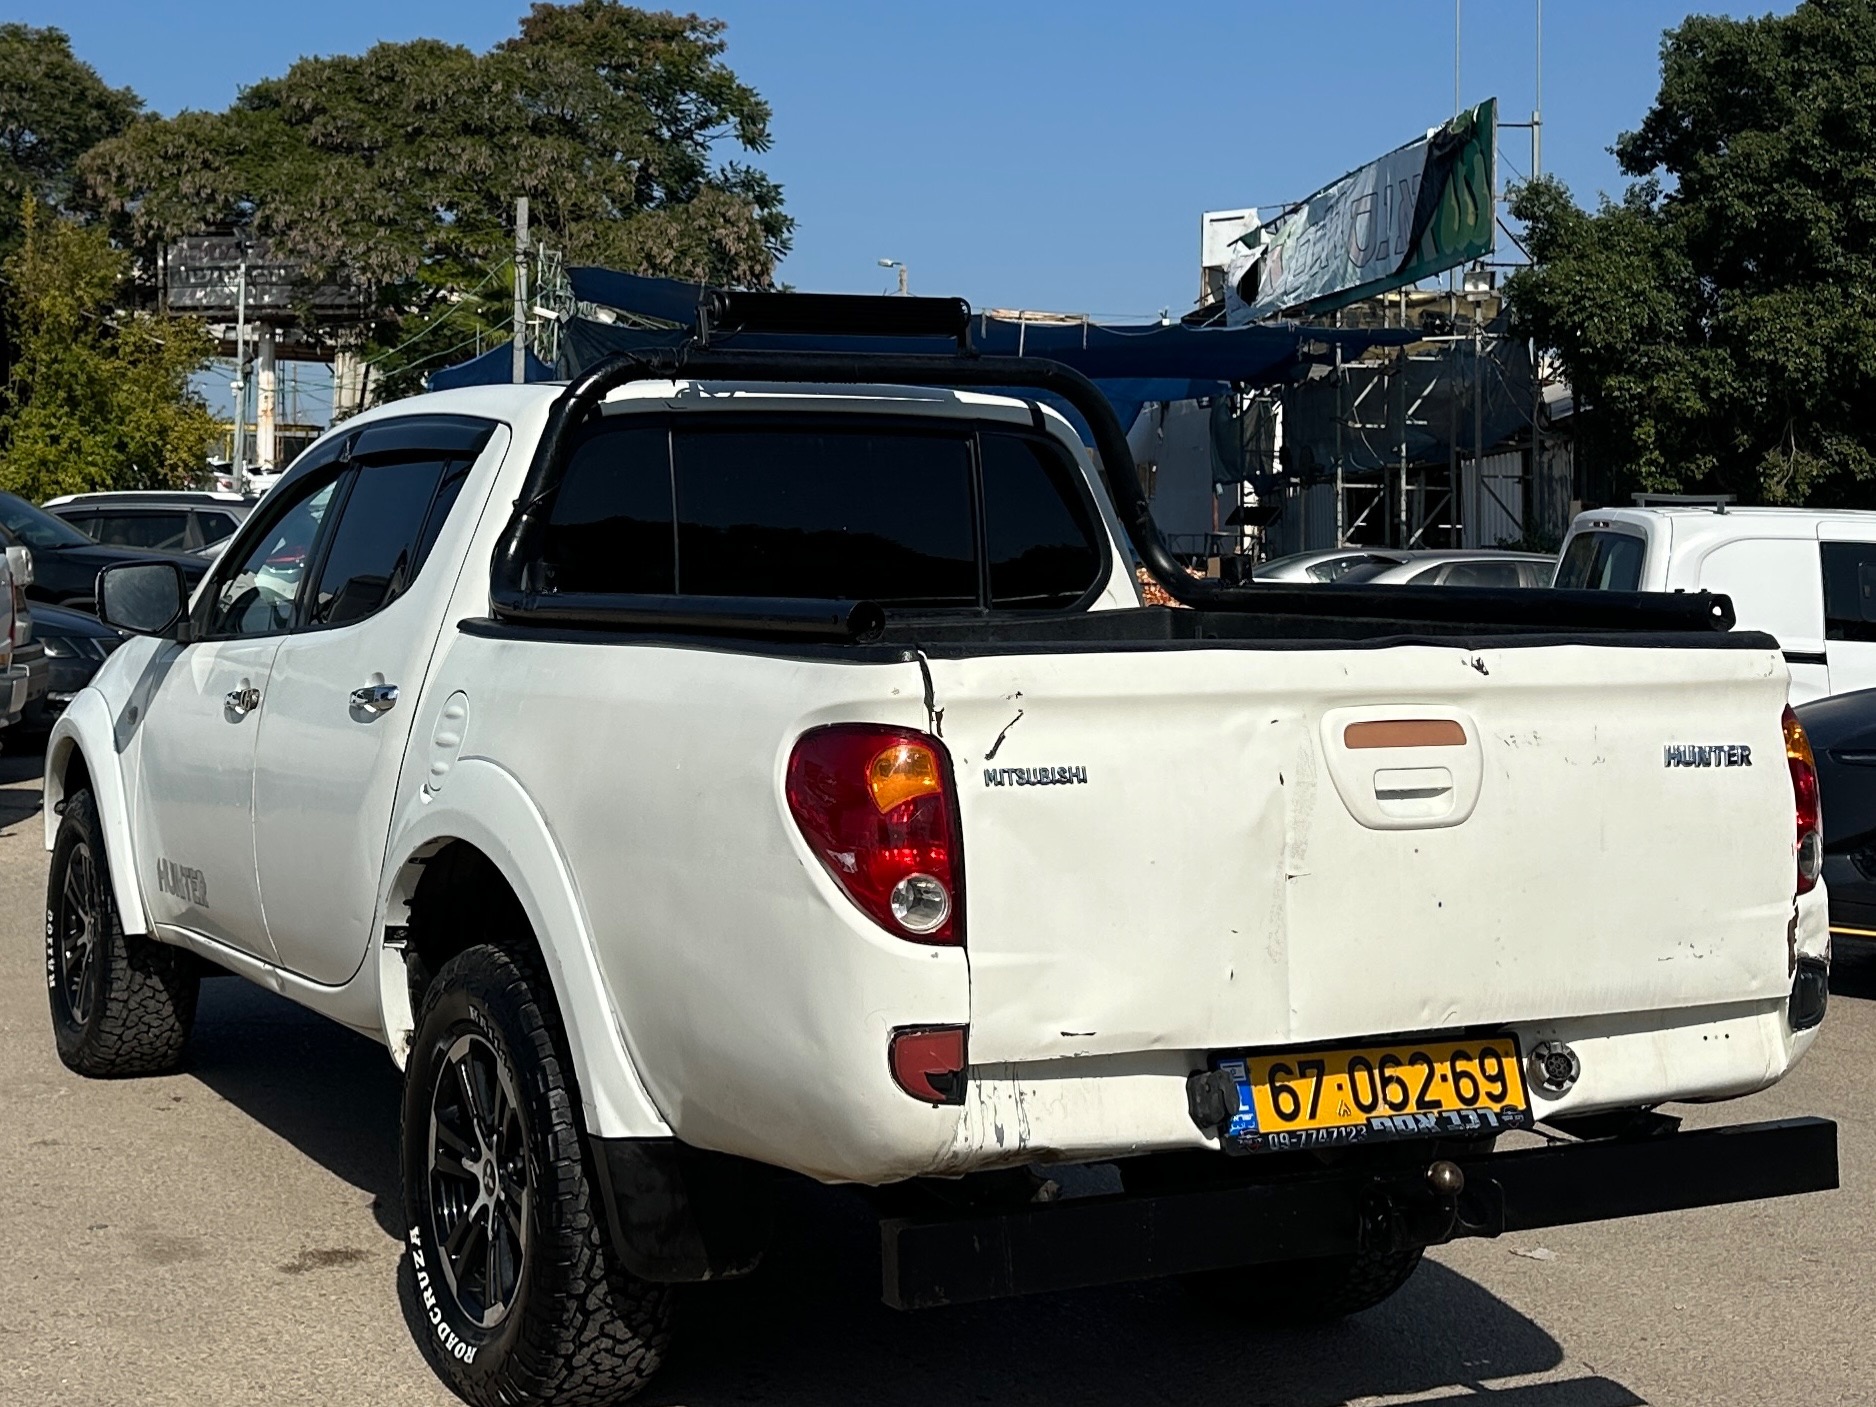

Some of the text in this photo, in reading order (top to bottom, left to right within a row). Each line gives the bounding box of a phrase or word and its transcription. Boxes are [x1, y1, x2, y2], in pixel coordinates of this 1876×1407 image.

[1664, 744, 1752, 768] HUNTER
[983, 766, 1088, 787] MITSUBISHI
[157, 857, 209, 908] HUNTER
[1442, 1108, 1499, 1131] רכב
[409, 1225, 478, 1364] ROADCRUZA
